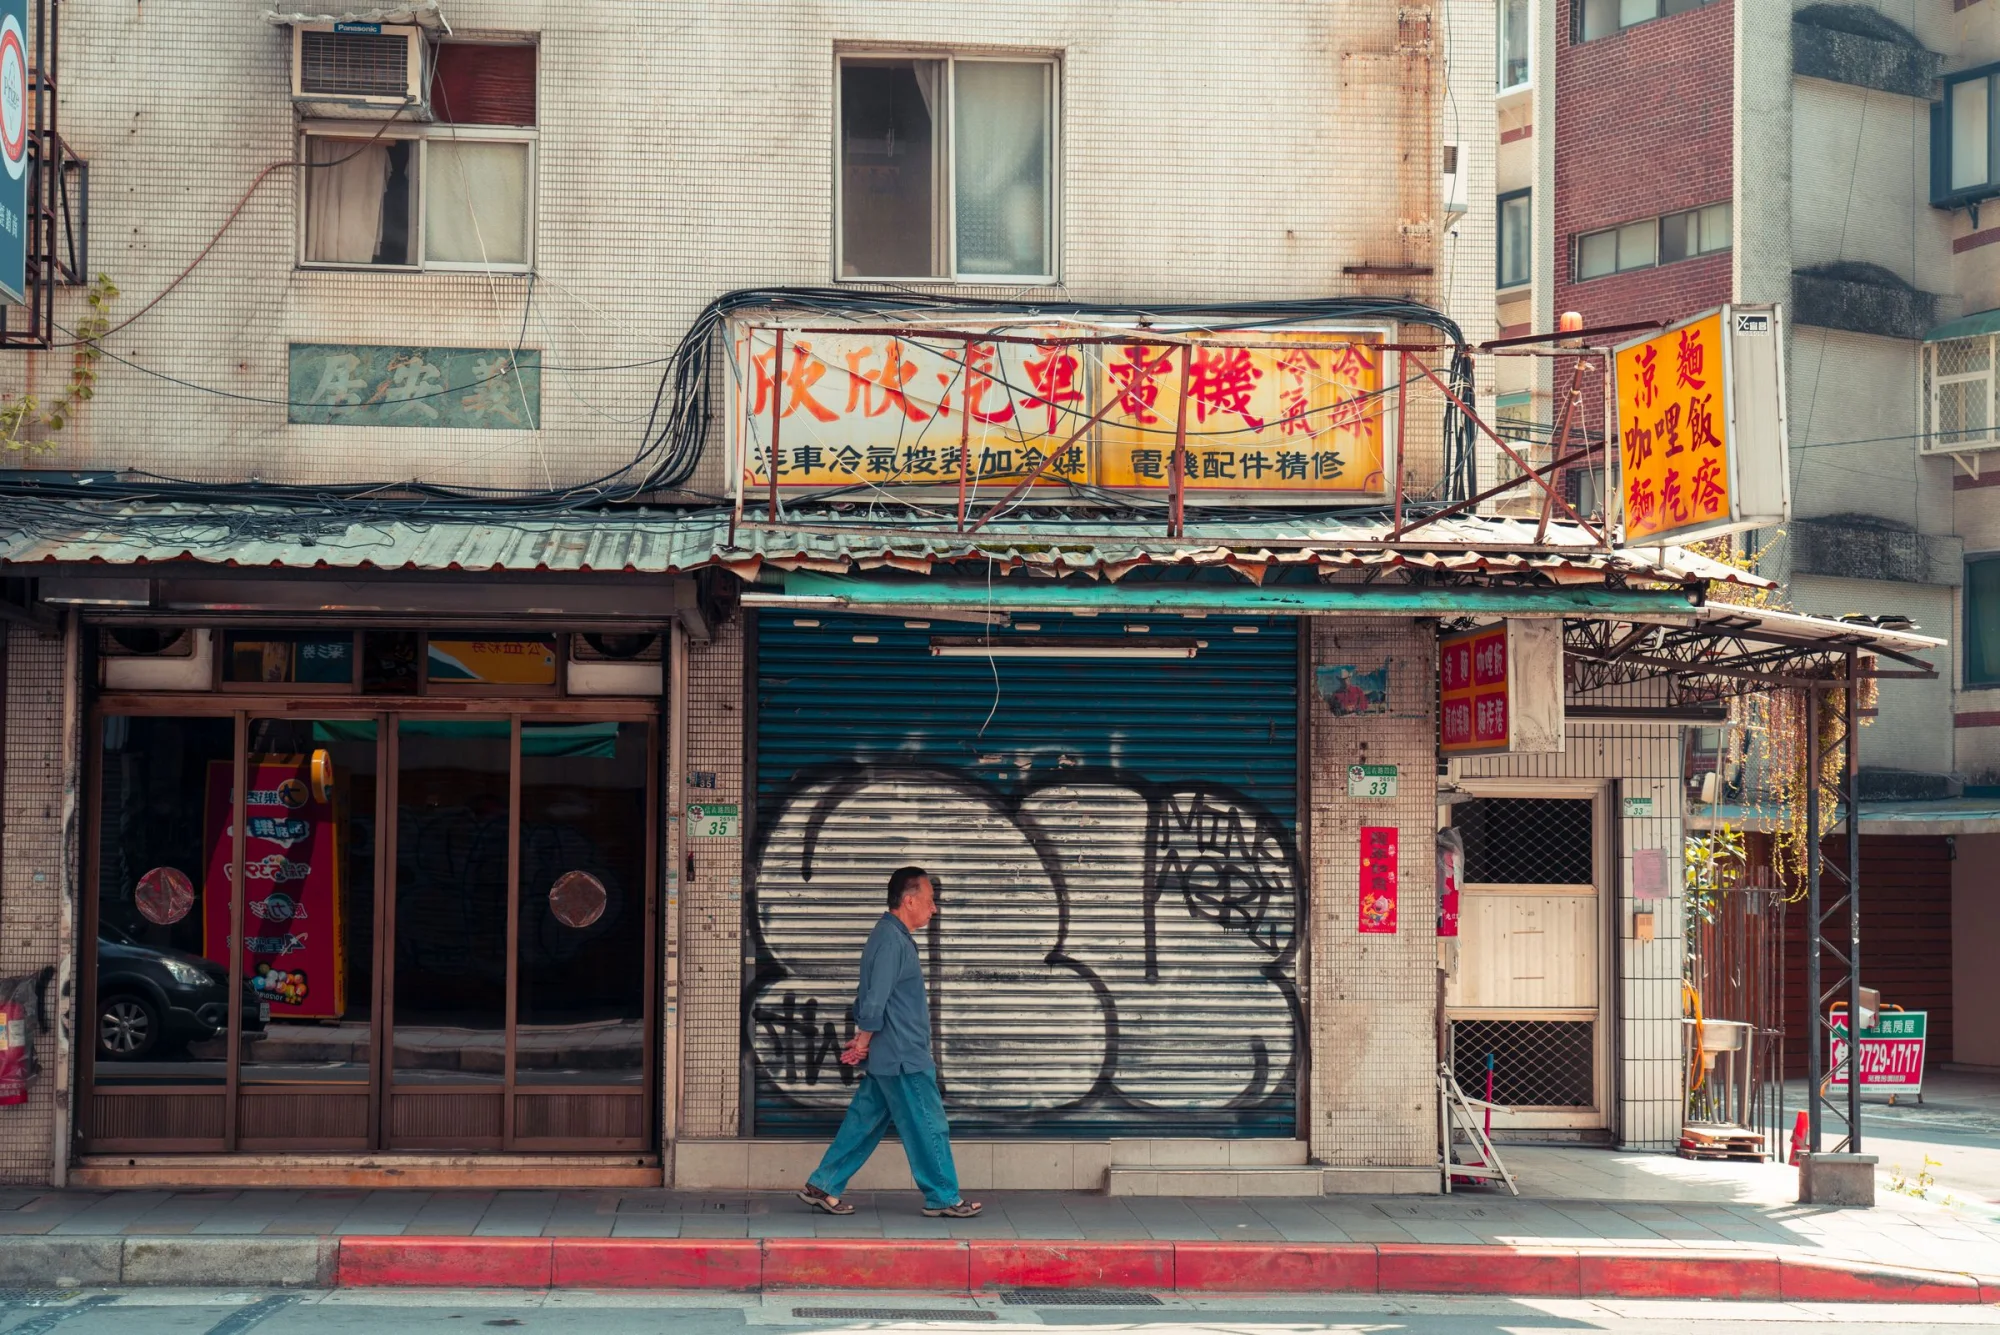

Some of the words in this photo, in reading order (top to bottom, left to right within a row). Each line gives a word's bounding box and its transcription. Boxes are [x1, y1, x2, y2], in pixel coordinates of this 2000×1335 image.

[338, 24, 378, 33] Panasonic
[751, 334, 1085, 435] 欣欣汽車
[1109, 345, 1264, 434] 電機
[1624, 393, 1722, 471] 咖哩飯
[1131, 449, 1346, 480] 電機配件精修
[1628, 456, 1726, 531] 麵疙瘩
[1369, 782, 1388, 796] 33
[1633, 807, 1643, 815] 33
[708, 822, 728, 835] 35
[1860, 1043, 1920, 1073] 2729-1717
